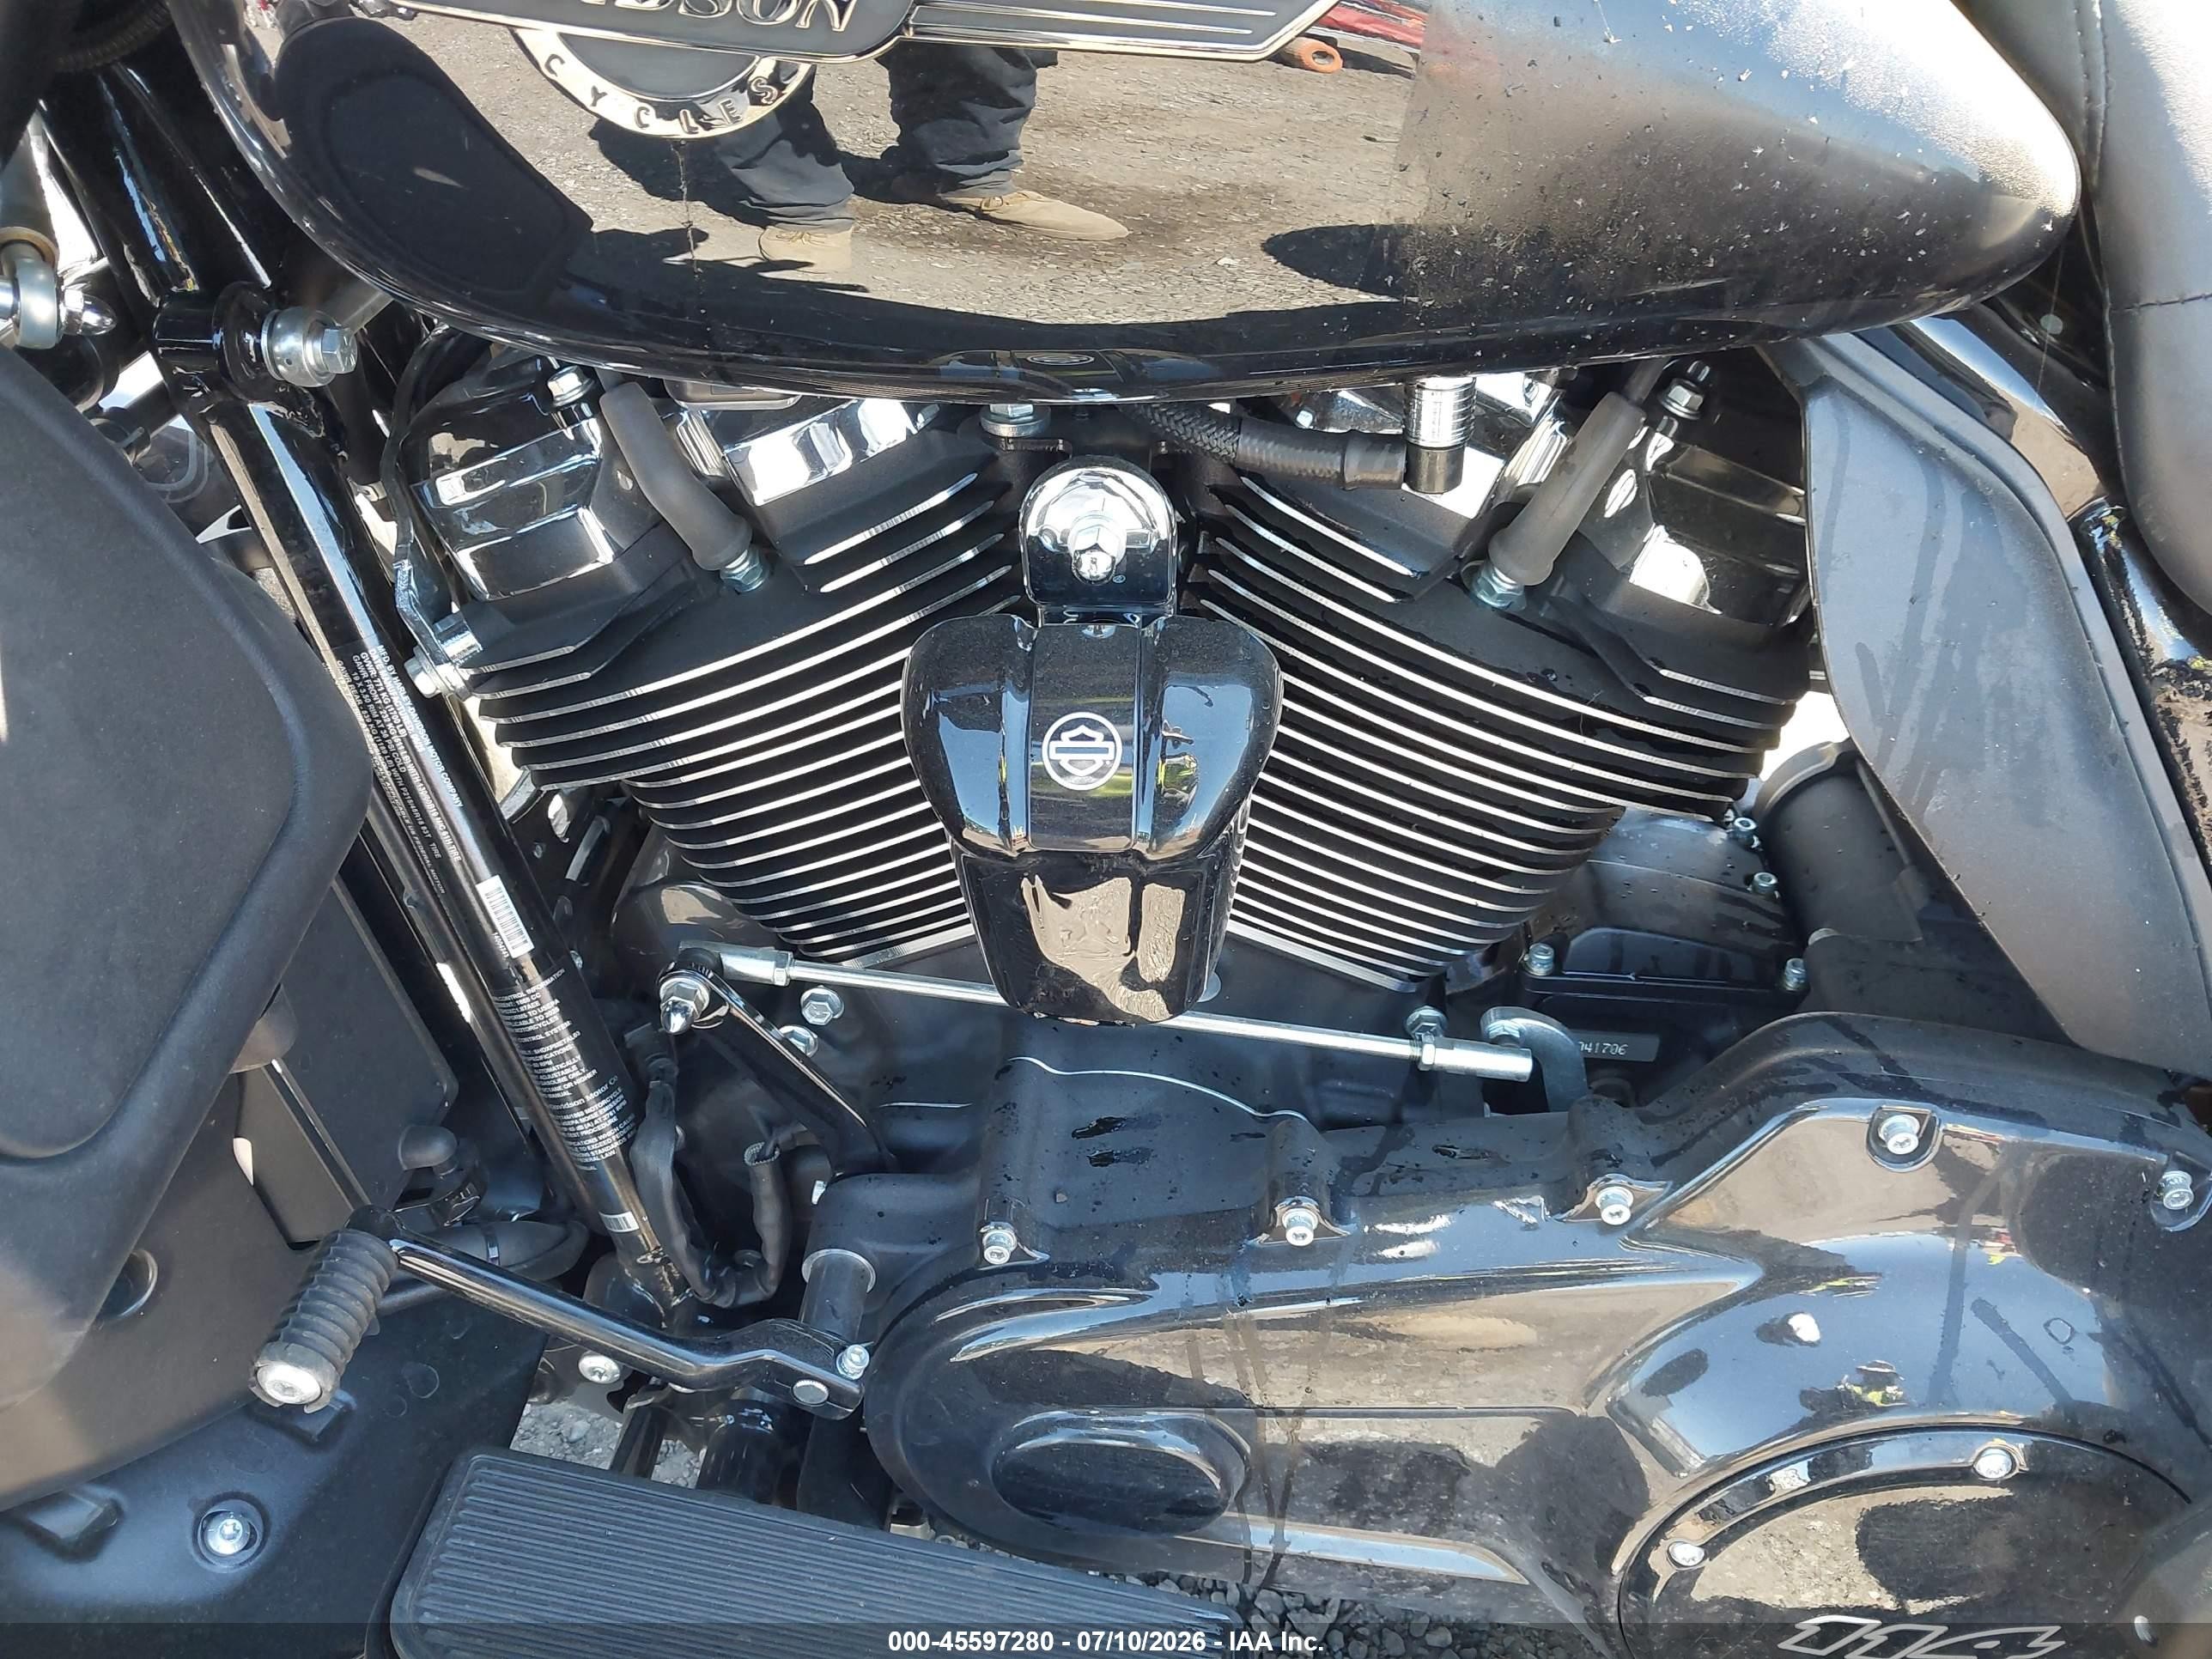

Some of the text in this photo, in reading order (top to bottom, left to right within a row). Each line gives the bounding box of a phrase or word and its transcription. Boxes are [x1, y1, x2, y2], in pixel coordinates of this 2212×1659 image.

[544, 53, 779, 136] CYCLES
[380, 690, 391, 704] KG
[348, 683, 363, 705] REAR
[390, 767, 404, 787] WITH
[428, 842, 441, 860] TIRE
[351, 653, 368, 678] GAWR
[363, 678, 382, 705] FRONT
[386, 721, 397, 735] KG
[405, 763, 421, 783] WITH
[447, 844, 461, 862] TIRE
[366, 702, 379, 718] RIM
[384, 738, 396, 751] PSI
[391, 750, 407, 774] COLD
[391, 675, 433, 746] HARLEY-DAVIDSON
[426, 744, 445, 773] MOTOR
[439, 771, 464, 809] COMPANY
[580, 1115, 618, 1135] PROCEDURE
[584, 1082, 609, 1102] Motor
